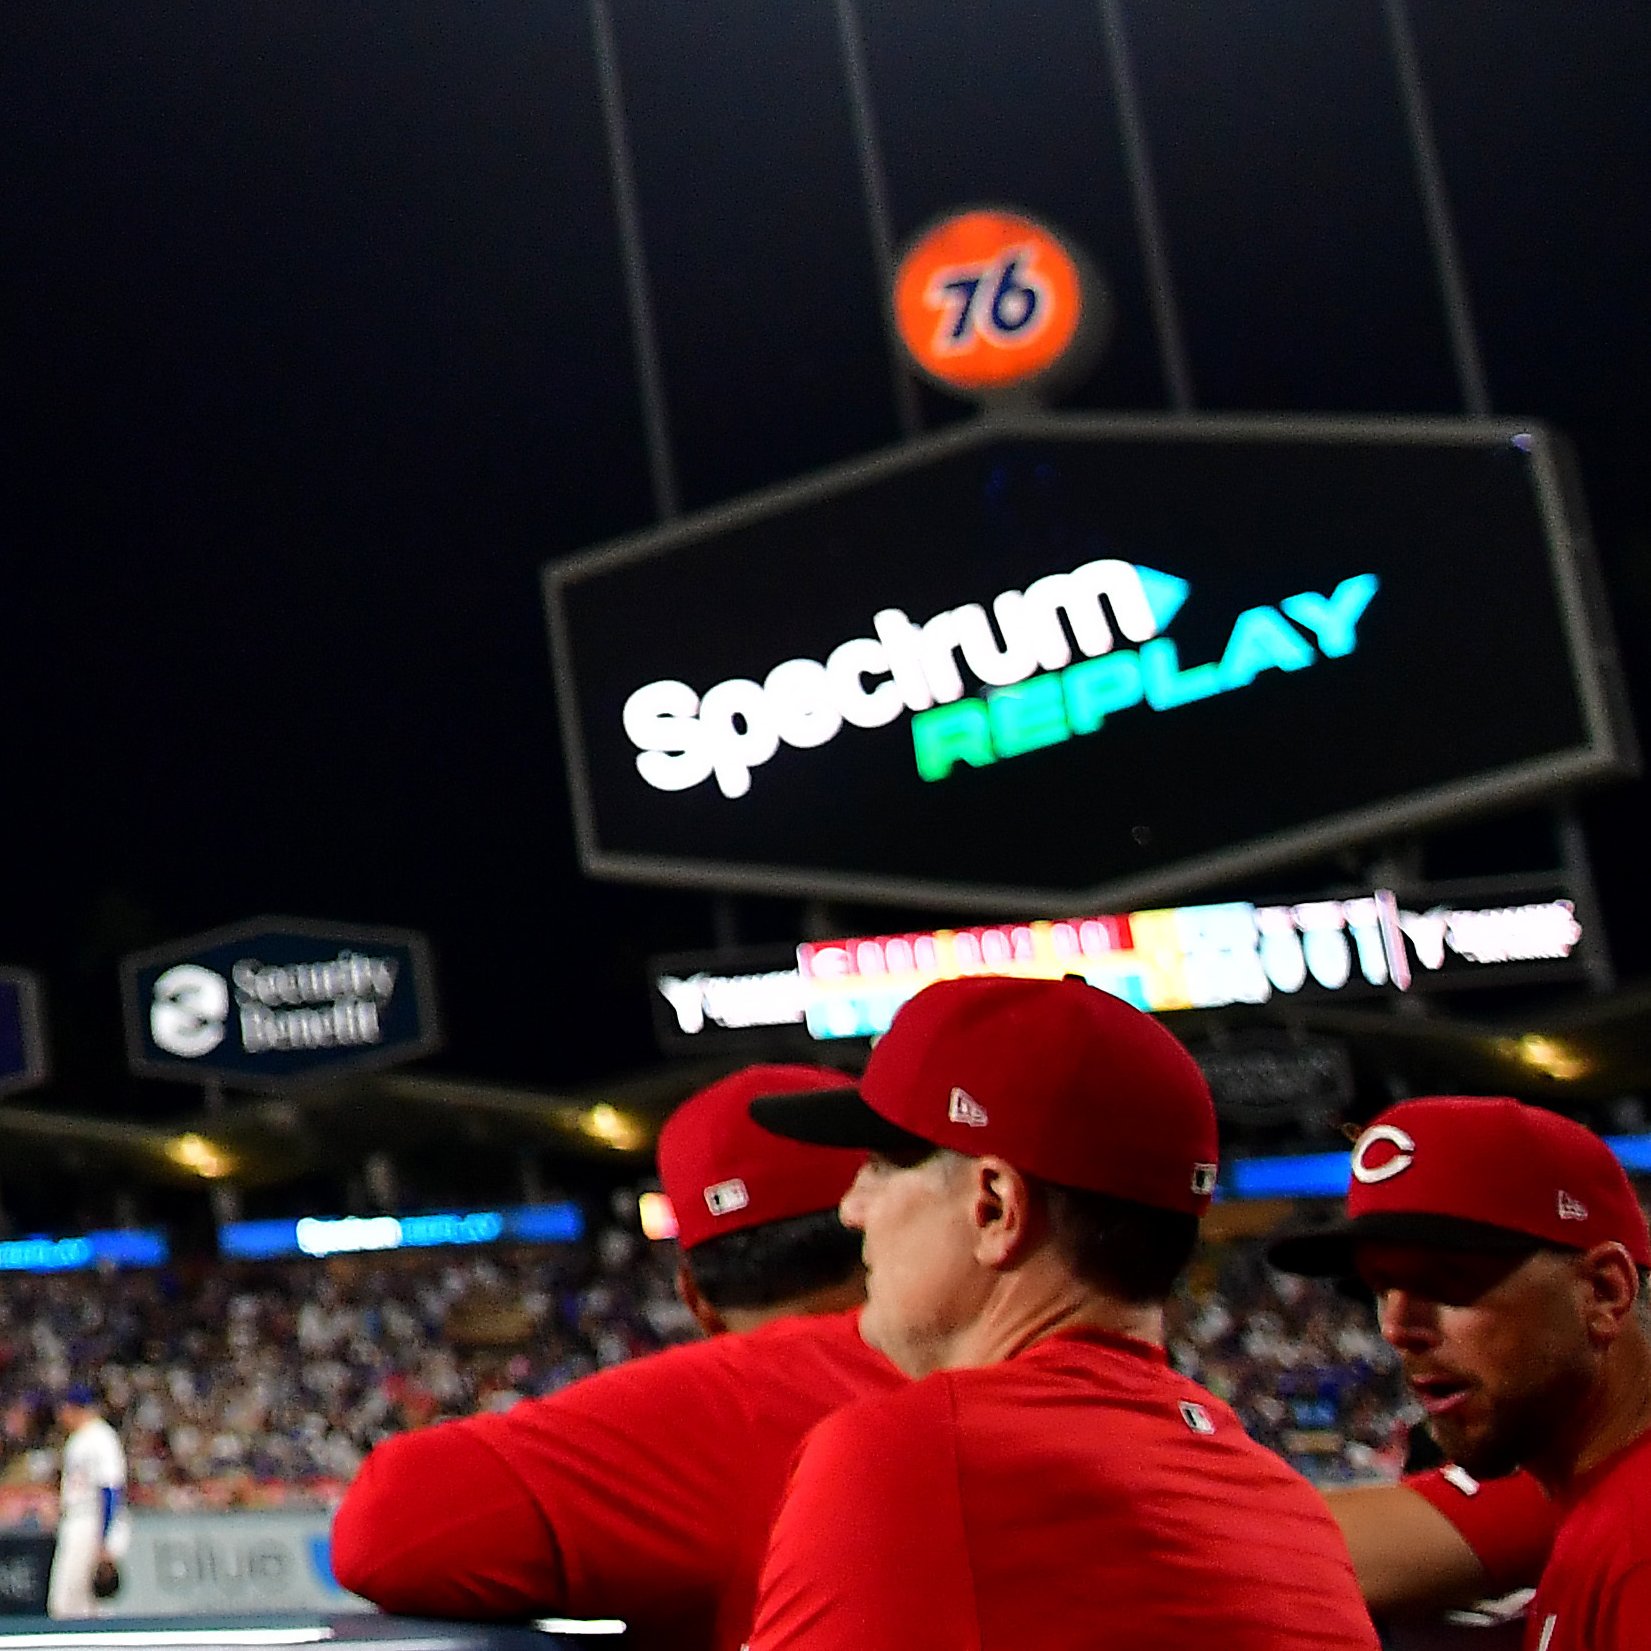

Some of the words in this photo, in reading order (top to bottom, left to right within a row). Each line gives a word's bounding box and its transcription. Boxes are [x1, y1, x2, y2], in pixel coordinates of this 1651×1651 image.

[935, 252, 1043, 347] 76
[623, 559, 1160, 798] Spectrum
[912, 573, 1379, 782] REPLAY
[233, 951, 396, 1005] Security
[241, 999, 381, 1053] Benefit
[154, 1537, 291, 1595] blue
